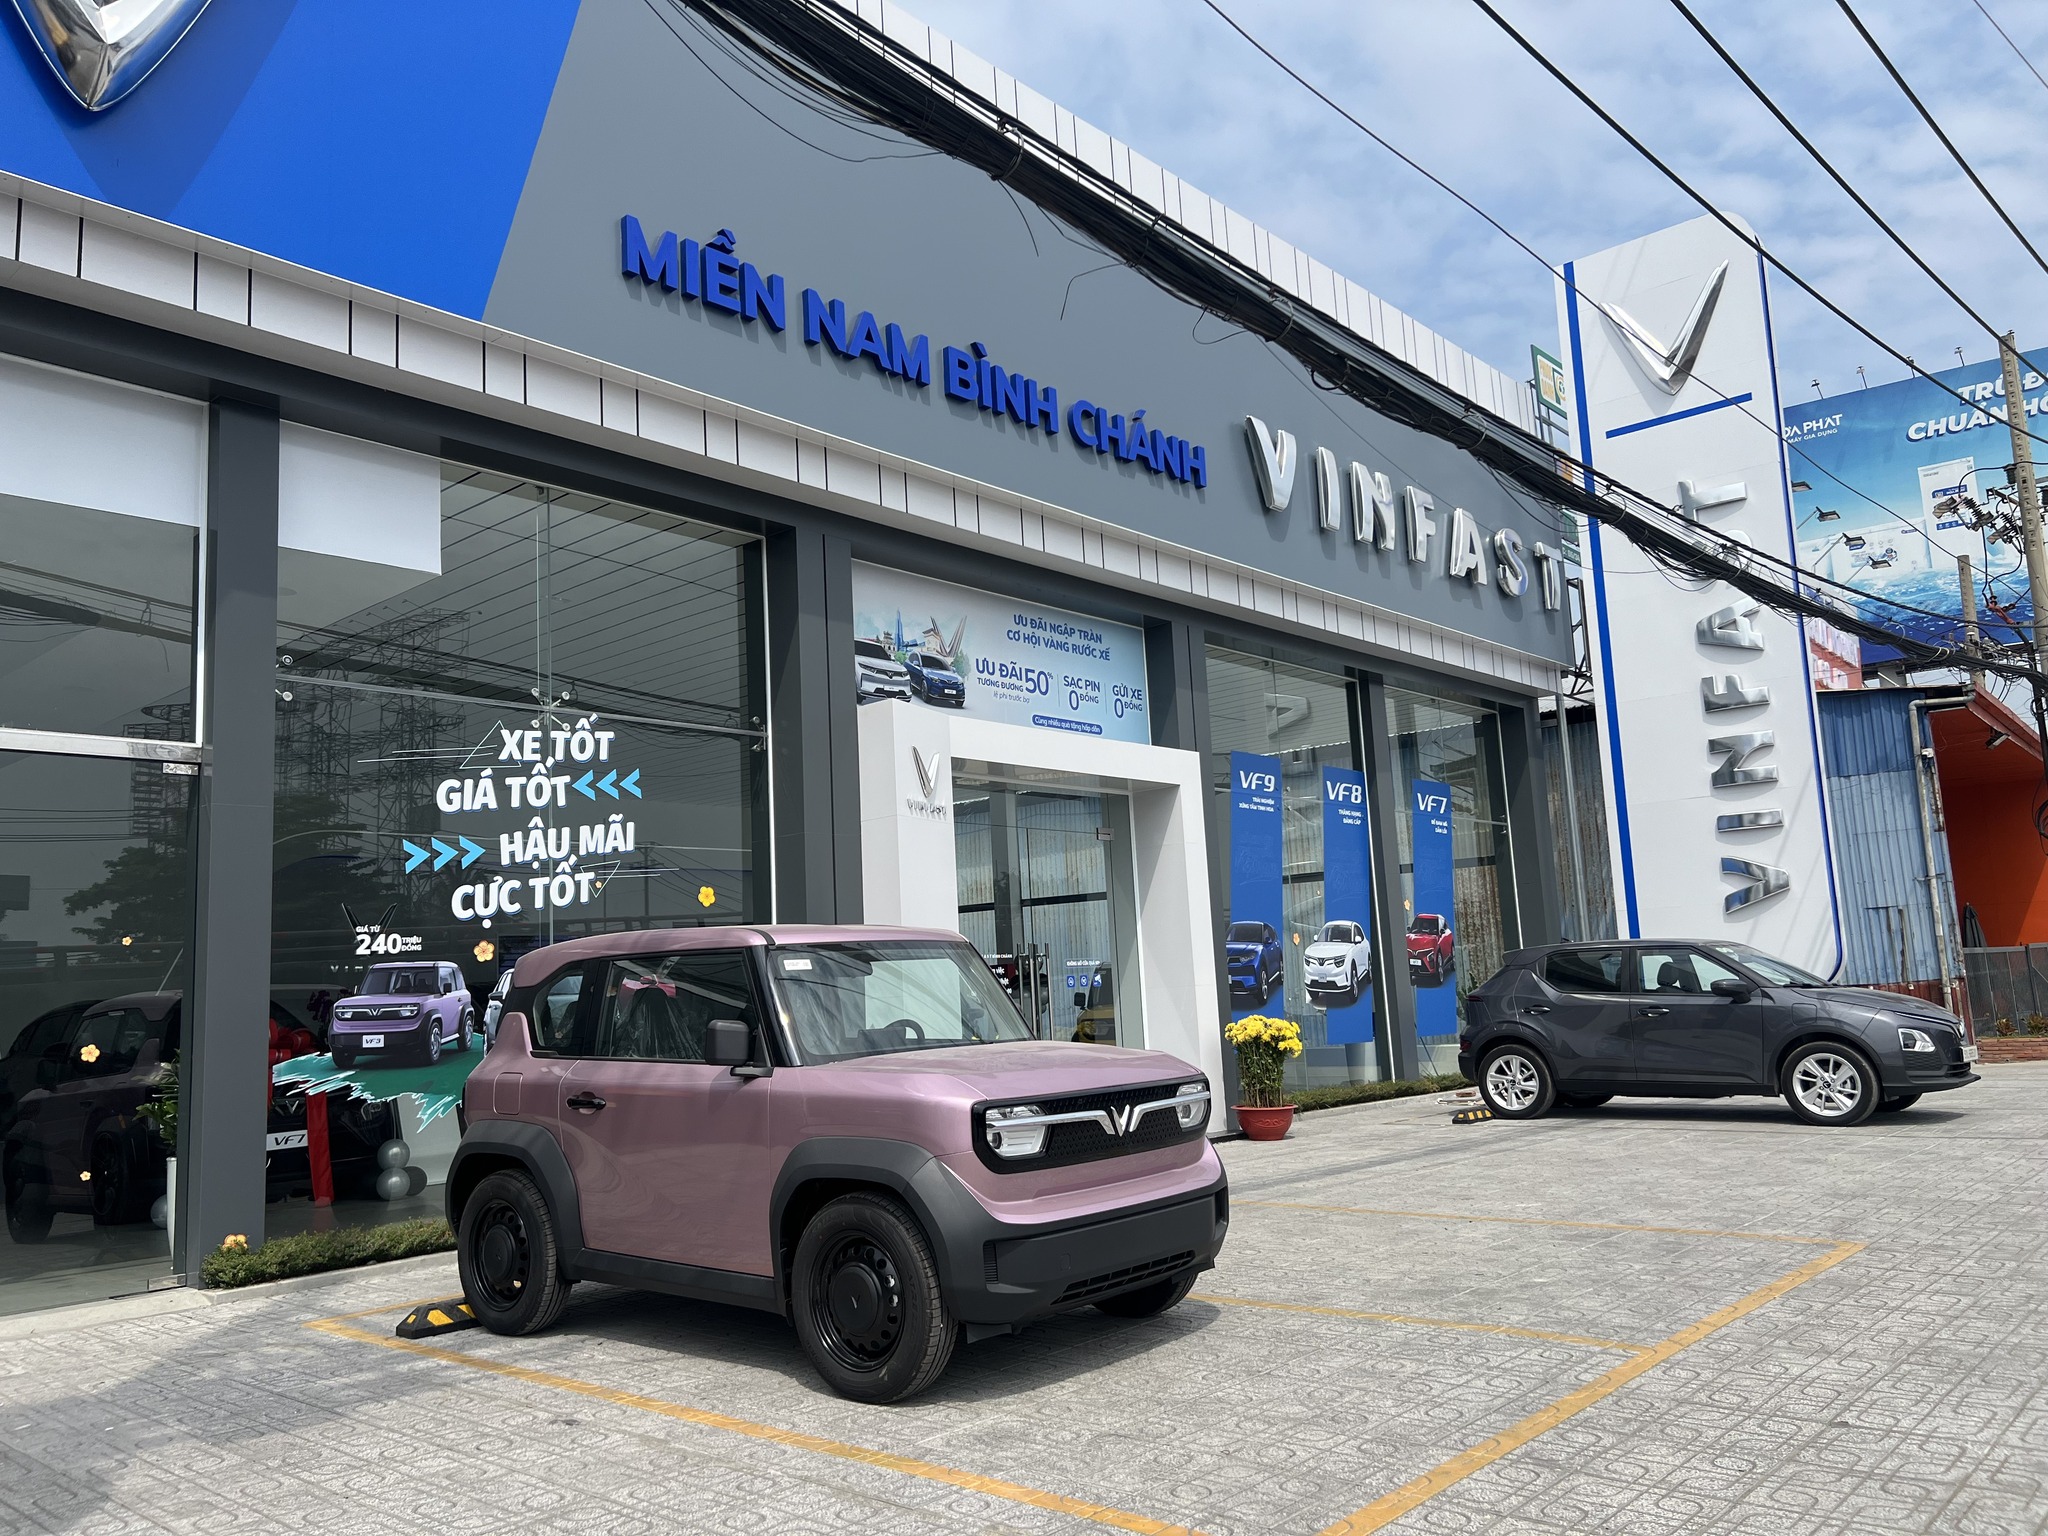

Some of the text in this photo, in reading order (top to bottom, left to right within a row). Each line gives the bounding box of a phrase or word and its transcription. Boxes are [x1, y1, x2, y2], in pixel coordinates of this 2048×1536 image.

[621, 213, 1206, 489] MIỀN NAM BÌNH CHÁNH
[2022, 371, 2048, 390] Đ
[1803, 413, 1843, 434] PHÁT
[1817, 428, 1838, 437] DỤNG
[1245, 414, 1562, 612] VINFAST
[1013, 613, 1103, 644] ƯU ĐÃI NGẬP TRÀN
[1007, 629, 1021, 641] CƠ
[1022, 632, 1041, 648] HỘI
[1042, 636, 1070, 652] VÀNG
[1071, 643, 1097, 658] RƯỚC
[975, 657, 995, 676] ƯU
[998, 661, 1023, 681] ĐÃI
[977, 677, 1024, 692] TƯƠNG ĐƯƠNG
[1063, 675, 1101, 692] SẠC PIN
[1112, 683, 1142, 700] GỬI XE
[1069, 690, 1079, 710] 0
[1114, 698, 1124, 718] 0
[498, 712, 615, 763] XE TỐT
[436, 755, 571, 813] GIÁ TỐT
[1239, 770, 1275, 792] VF9
[1326, 780, 1362, 804] VF8
[1417, 792, 1447, 814] VF7
[499, 813, 635, 869] HẬU MÃI
[451, 854, 595, 929] CỰC TỐT
[355, 924, 380, 933] GIÁ TỪ
[401, 935, 422, 944] TRIỆU
[355, 933, 402, 955] 240
[401, 943, 422, 951] ĐỒNG
[274, 1133, 306, 1146] VF7
